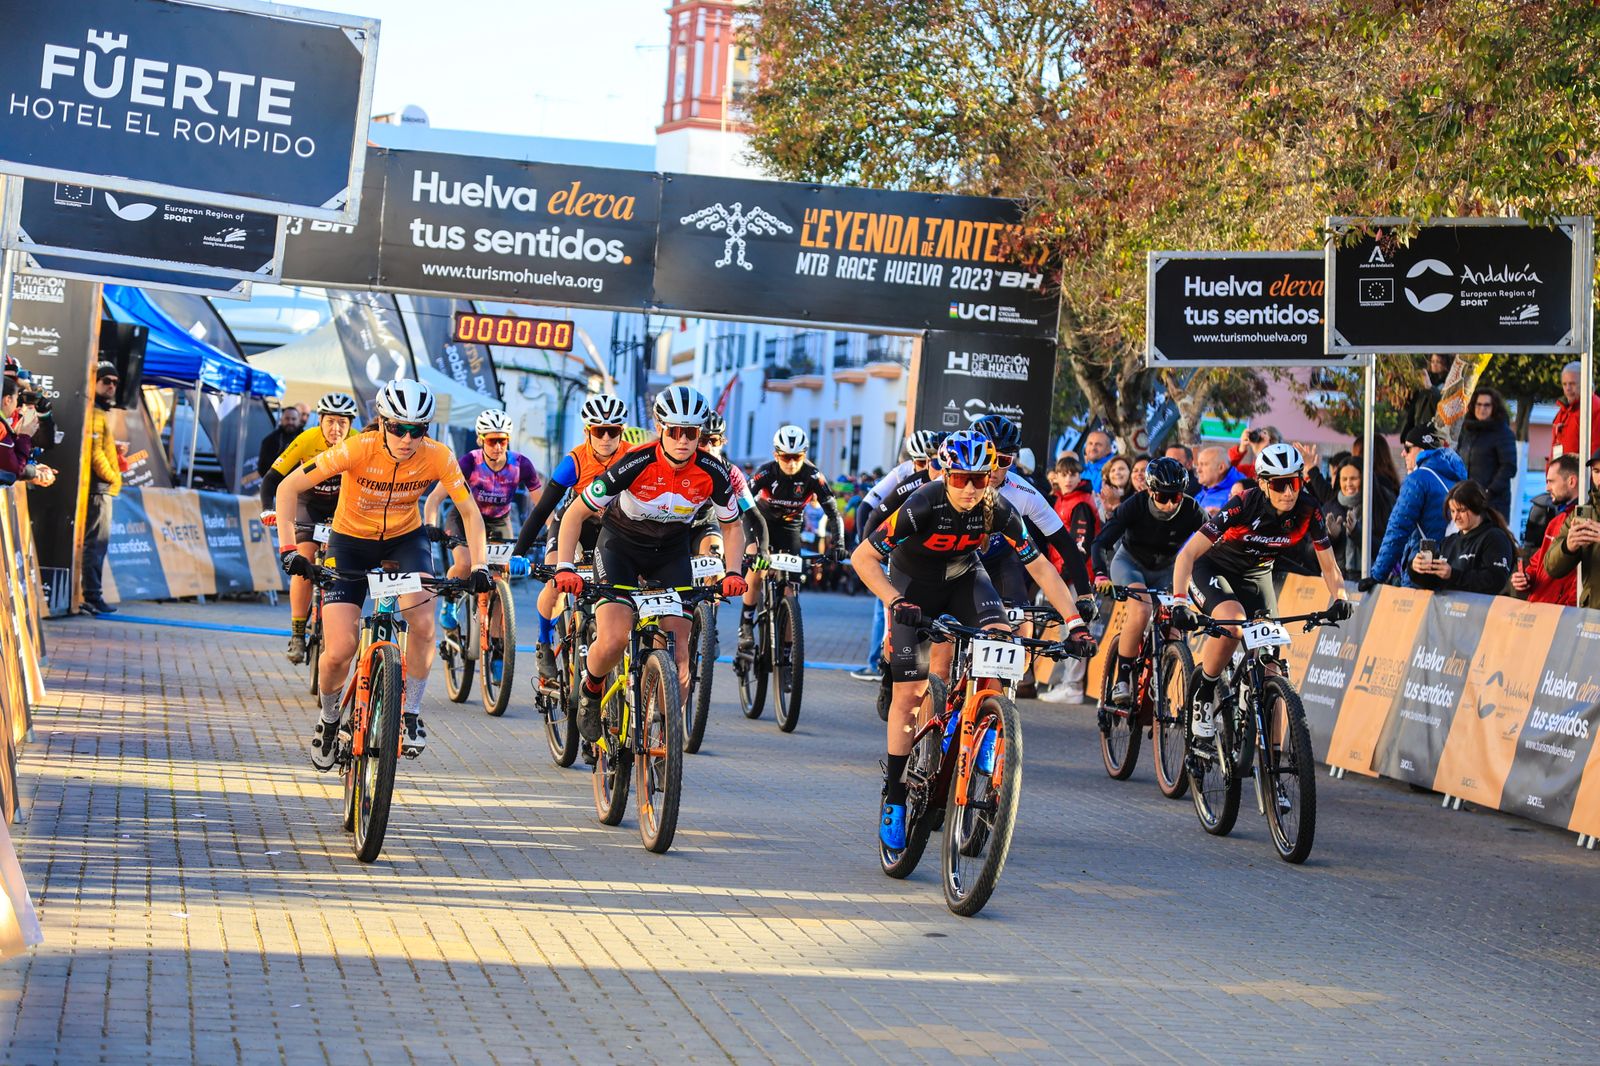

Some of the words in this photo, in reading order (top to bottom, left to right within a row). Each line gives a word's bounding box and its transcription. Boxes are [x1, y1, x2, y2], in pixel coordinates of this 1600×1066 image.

[40, 43, 296, 126] FUERTE
[9, 92, 112, 129] HOTEL
[125, 111, 159, 136] EL
[173, 118, 316, 158] ROMPIDO
[412, 170, 537, 213] Huelva
[547, 181, 635, 221] eleva
[163, 214, 194, 223] SPORT
[164, 204, 203, 216] European
[205, 210, 233, 220] Region
[235, 213, 244, 222] of
[804, 208, 818, 224] LA
[409, 217, 466, 250] tus
[472, 226, 632, 265] sentidos.
[921, 241, 935, 257] DE
[422, 262, 603, 292] www.turismohuelva.org
[795, 252, 830, 277] MTB
[835, 256, 878, 281] RACE
[884, 260, 943, 288] HUELVA
[950, 266, 993, 291] 2023
[999, 271, 1043, 290] BH
[1460, 263, 1544, 285] Andalucía
[21, 285, 64, 297] HUELVA
[1184, 276, 1262, 298] Huelva
[1269, 274, 1324, 297] eleva
[1460, 290, 1497, 299] European
[1499, 290, 1525, 298] Region
[1527, 289, 1535, 298] of
[958, 303, 997, 322] UCI
[1460, 299, 1488, 307] SPORT
[1184, 305, 1219, 326] tus
[1224, 304, 1324, 326] sentidos.
[1193, 332, 1308, 345] www.turismohuelva.org
[971, 352, 1030, 366] DIPUTACIÓN
[971, 362, 984, 371] DE
[988, 364, 1028, 374] HUELVA
[160, 524, 200, 543] FUERTE
[923, 532, 987, 551] BH
[487, 545, 509, 556] 117
[694, 558, 717, 570] 105
[1250, 626, 1280, 640] 104
[1316, 633, 1341, 657] Huelva
[982, 646, 1016, 664] 111
[1412, 645, 1446, 673] Huelva
[1307, 664, 1319, 684] tus
[1403, 678, 1419, 700] tus
[1418, 683, 1455, 709] sentidos.
[1540, 670, 1577, 700] Huelva
[1530, 706, 1546, 729] tus
[1545, 710, 1590, 740] sentidos.
